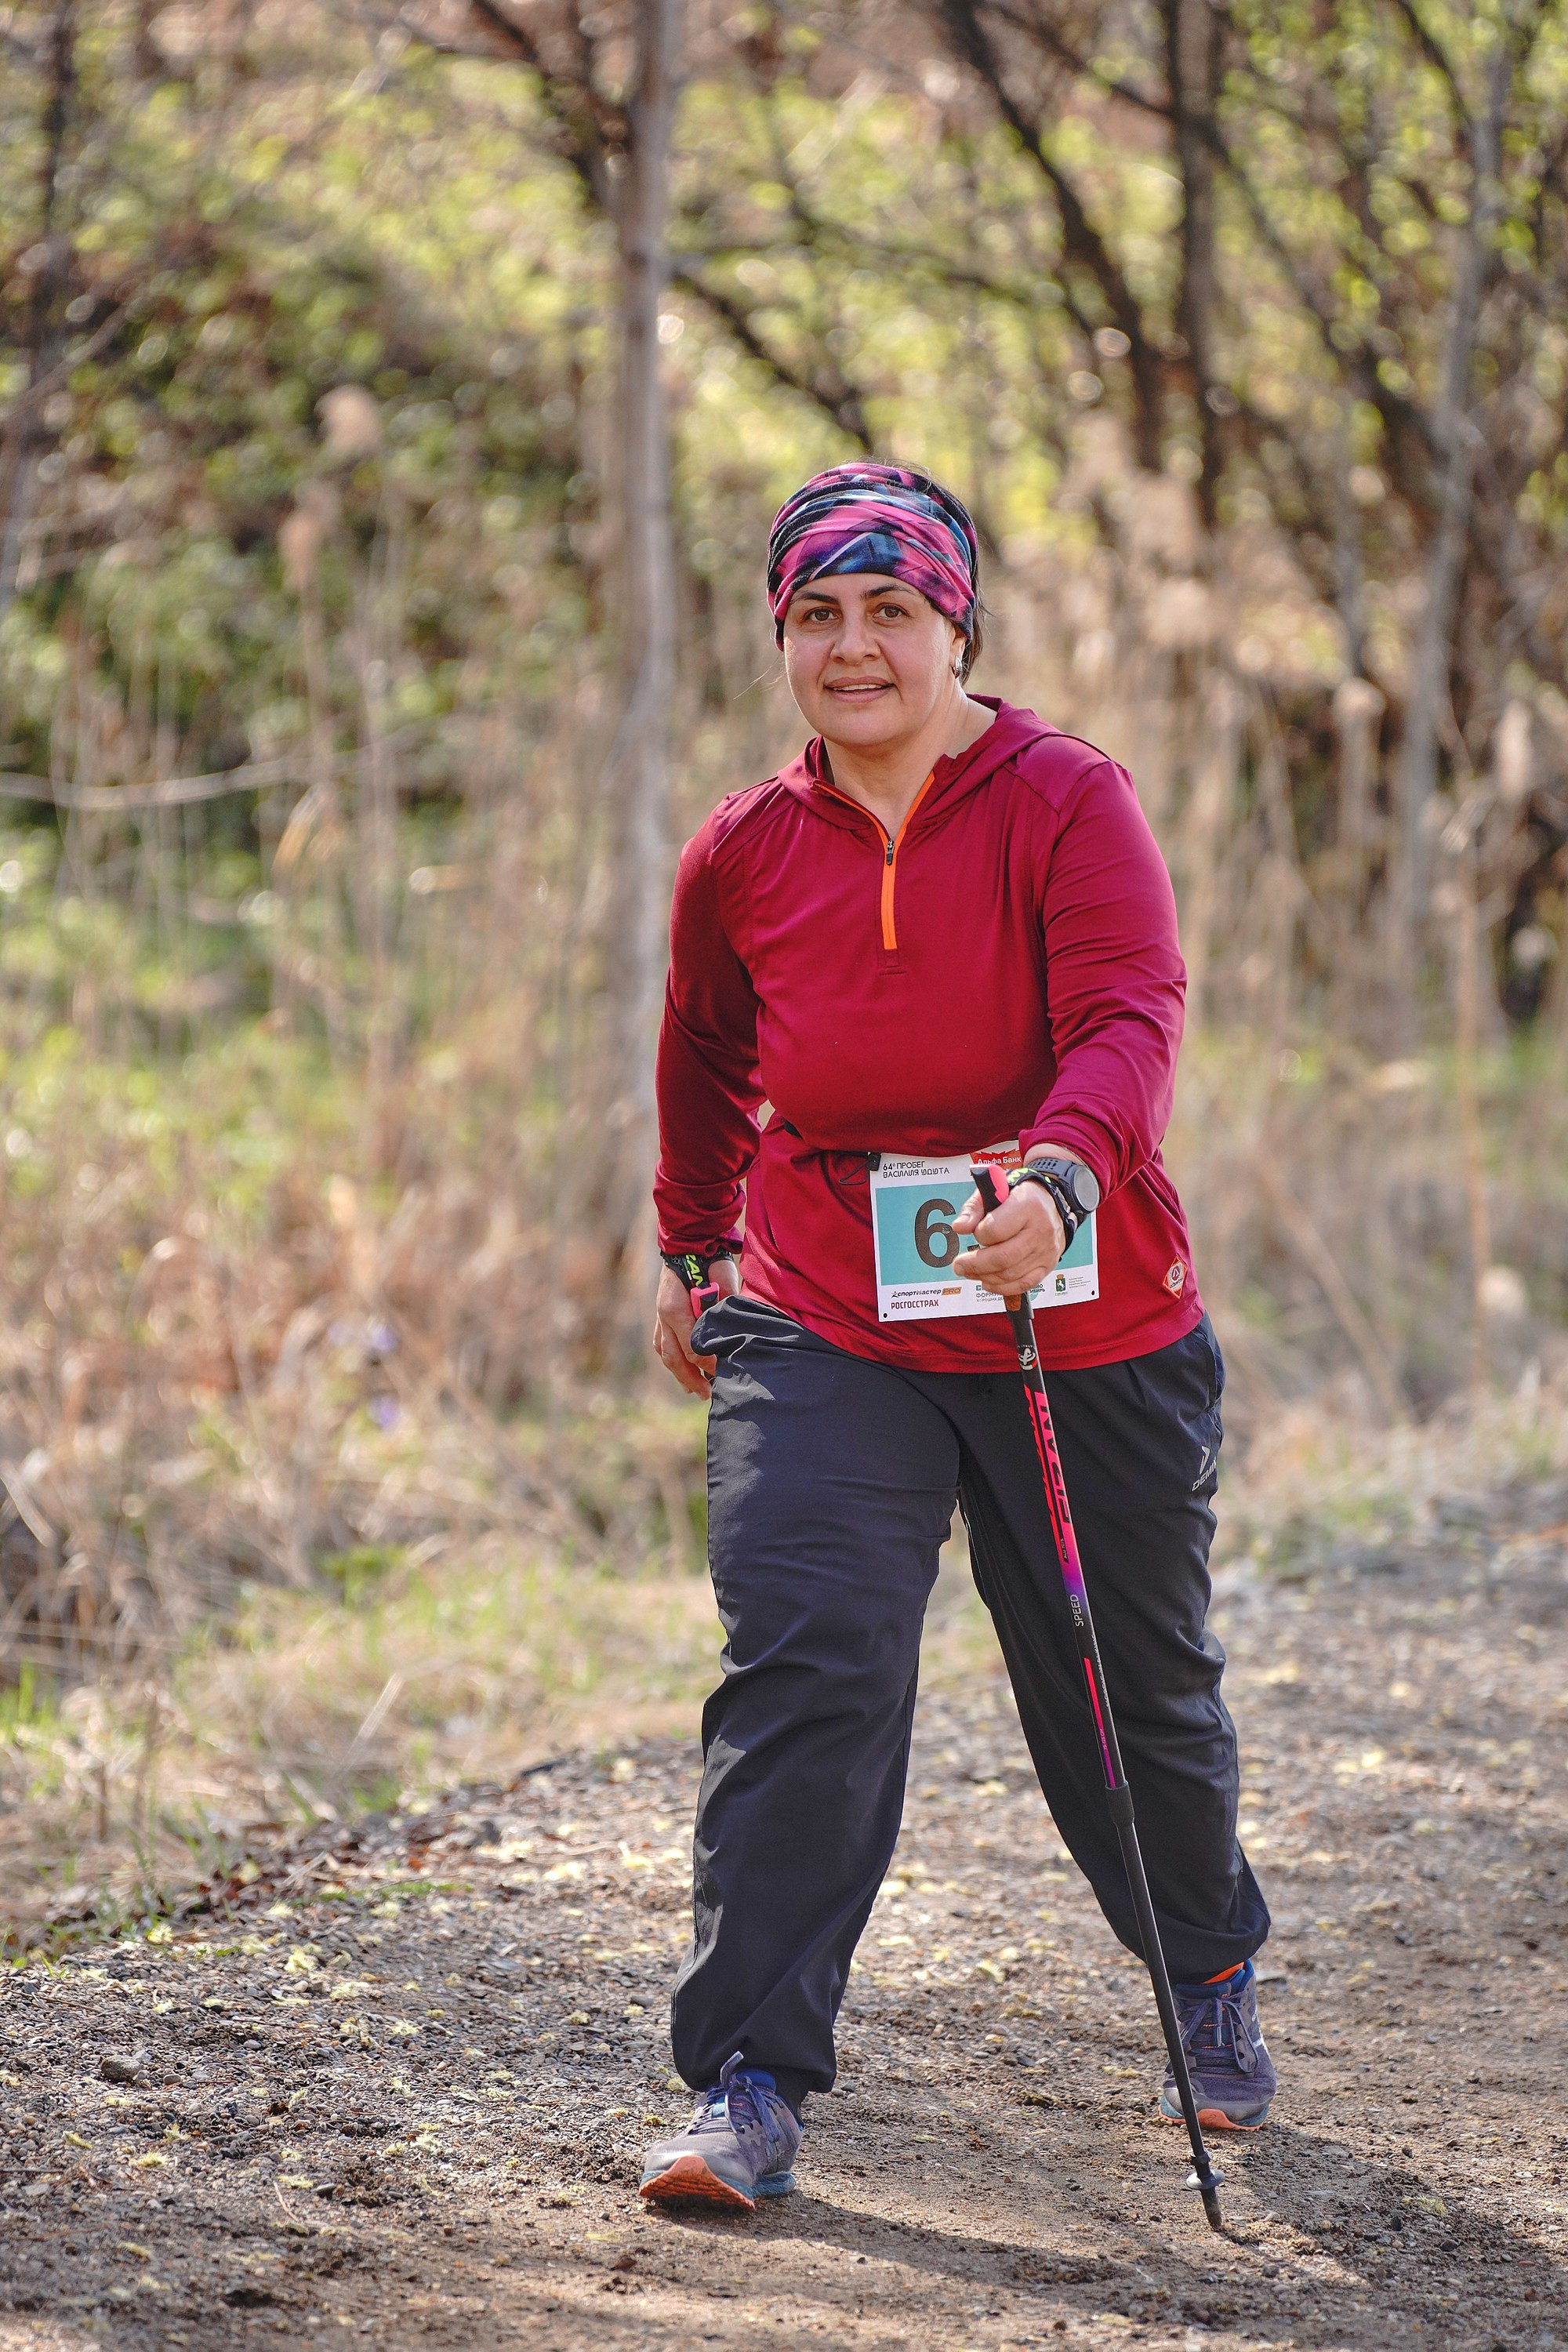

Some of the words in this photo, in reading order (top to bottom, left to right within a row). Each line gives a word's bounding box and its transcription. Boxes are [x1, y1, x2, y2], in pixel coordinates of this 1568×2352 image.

[896, 1160, 926, 1170] ПРОБЕГ
[977, 1156, 1001, 1166] Альфа
[1003, 1156, 1022, 1164] Банк
[883, 1169, 919, 1178] ВАСИЛИЯ
[942, 1287, 961, 1296] PRO
[891, 1299, 939, 1310] РОСГОССТРАХ
[1069, 1594, 1084, 1627] SPEED
